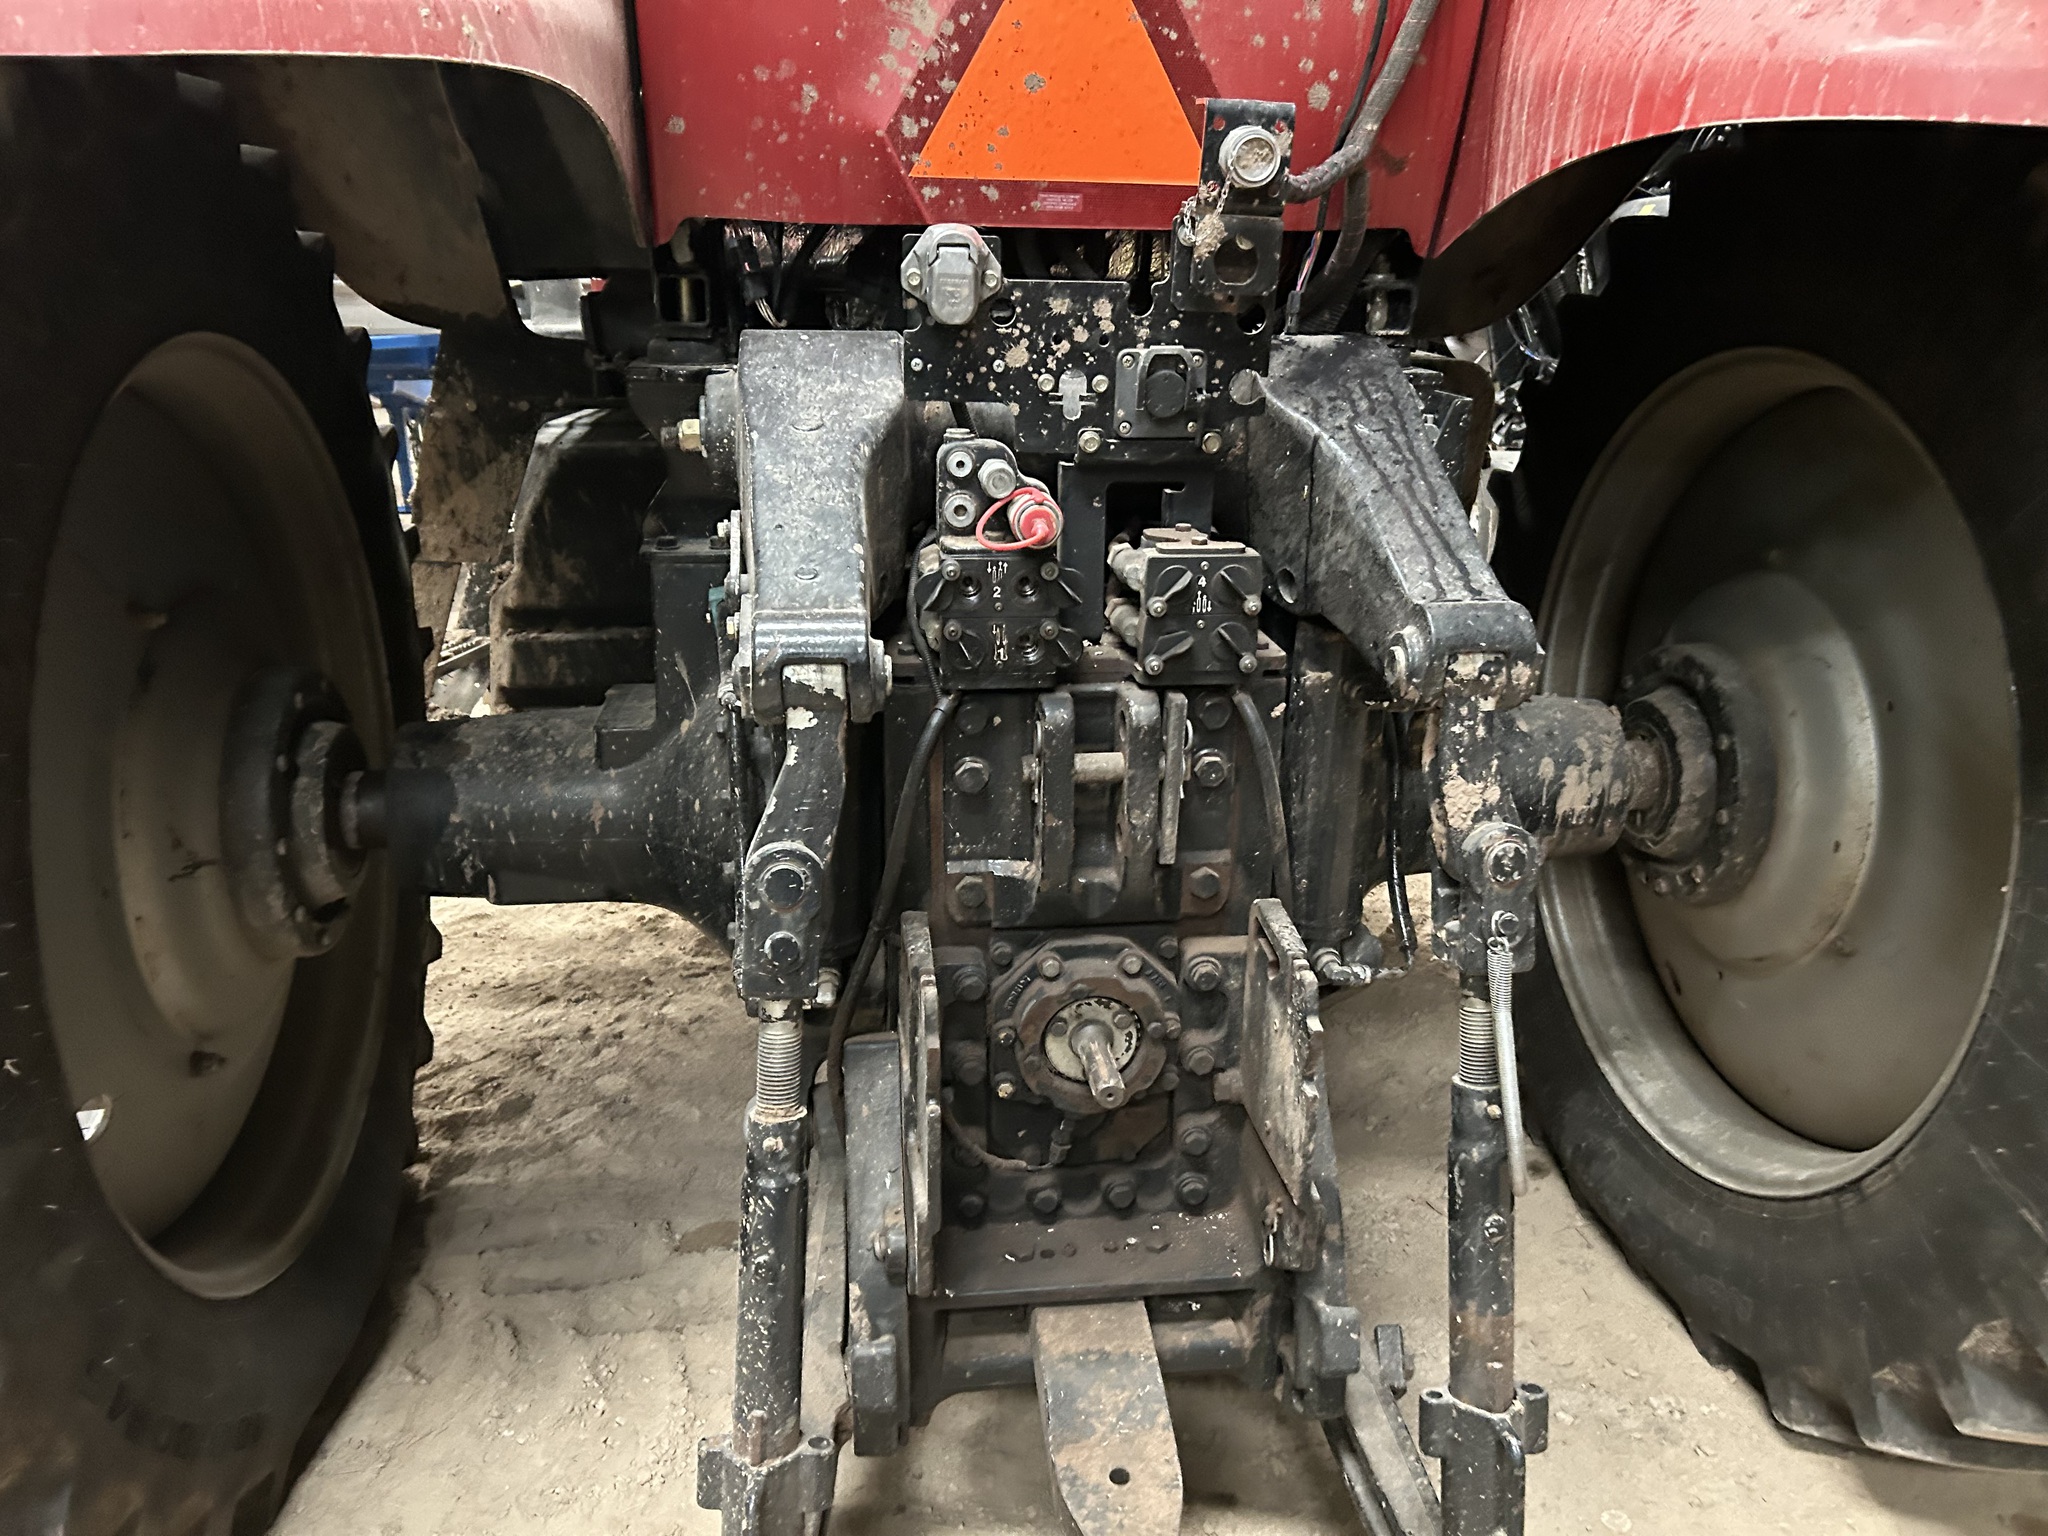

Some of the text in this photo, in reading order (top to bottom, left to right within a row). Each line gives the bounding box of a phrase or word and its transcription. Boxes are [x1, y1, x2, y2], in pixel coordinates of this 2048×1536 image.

[1198, 575, 1207, 587] 4
[993, 586, 1001, 598] 2
[997, 647, 1004, 660] 1
